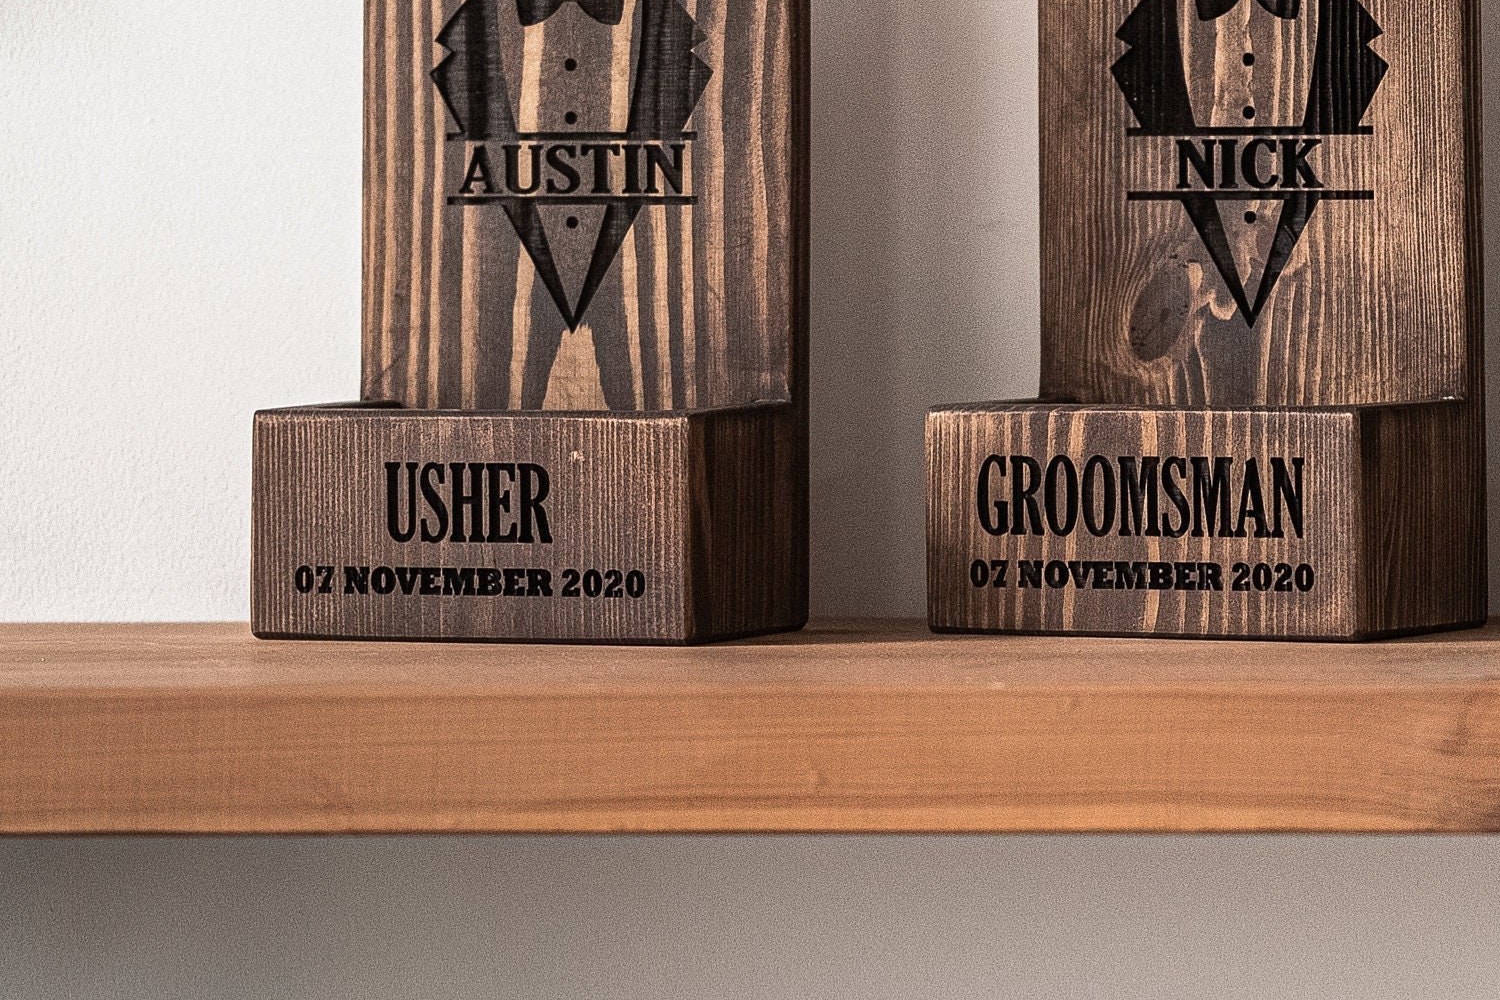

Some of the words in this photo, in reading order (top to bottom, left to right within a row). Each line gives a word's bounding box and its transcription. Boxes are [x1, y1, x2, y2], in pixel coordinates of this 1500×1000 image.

[458, 143, 686, 195] AUSTIN
[1175, 138, 1324, 190] NICK
[384, 461, 554, 544] USHER
[976, 453, 1305, 539] GROOMSMAN
[294, 565, 335, 594] 07
[344, 566, 554, 598] NOVEMBER
[561, 568, 646, 599] 2020
[969, 559, 1008, 589] 07
[1018, 560, 1224, 592] NOVEMBER
[1231, 562, 1315, 593] 2020
